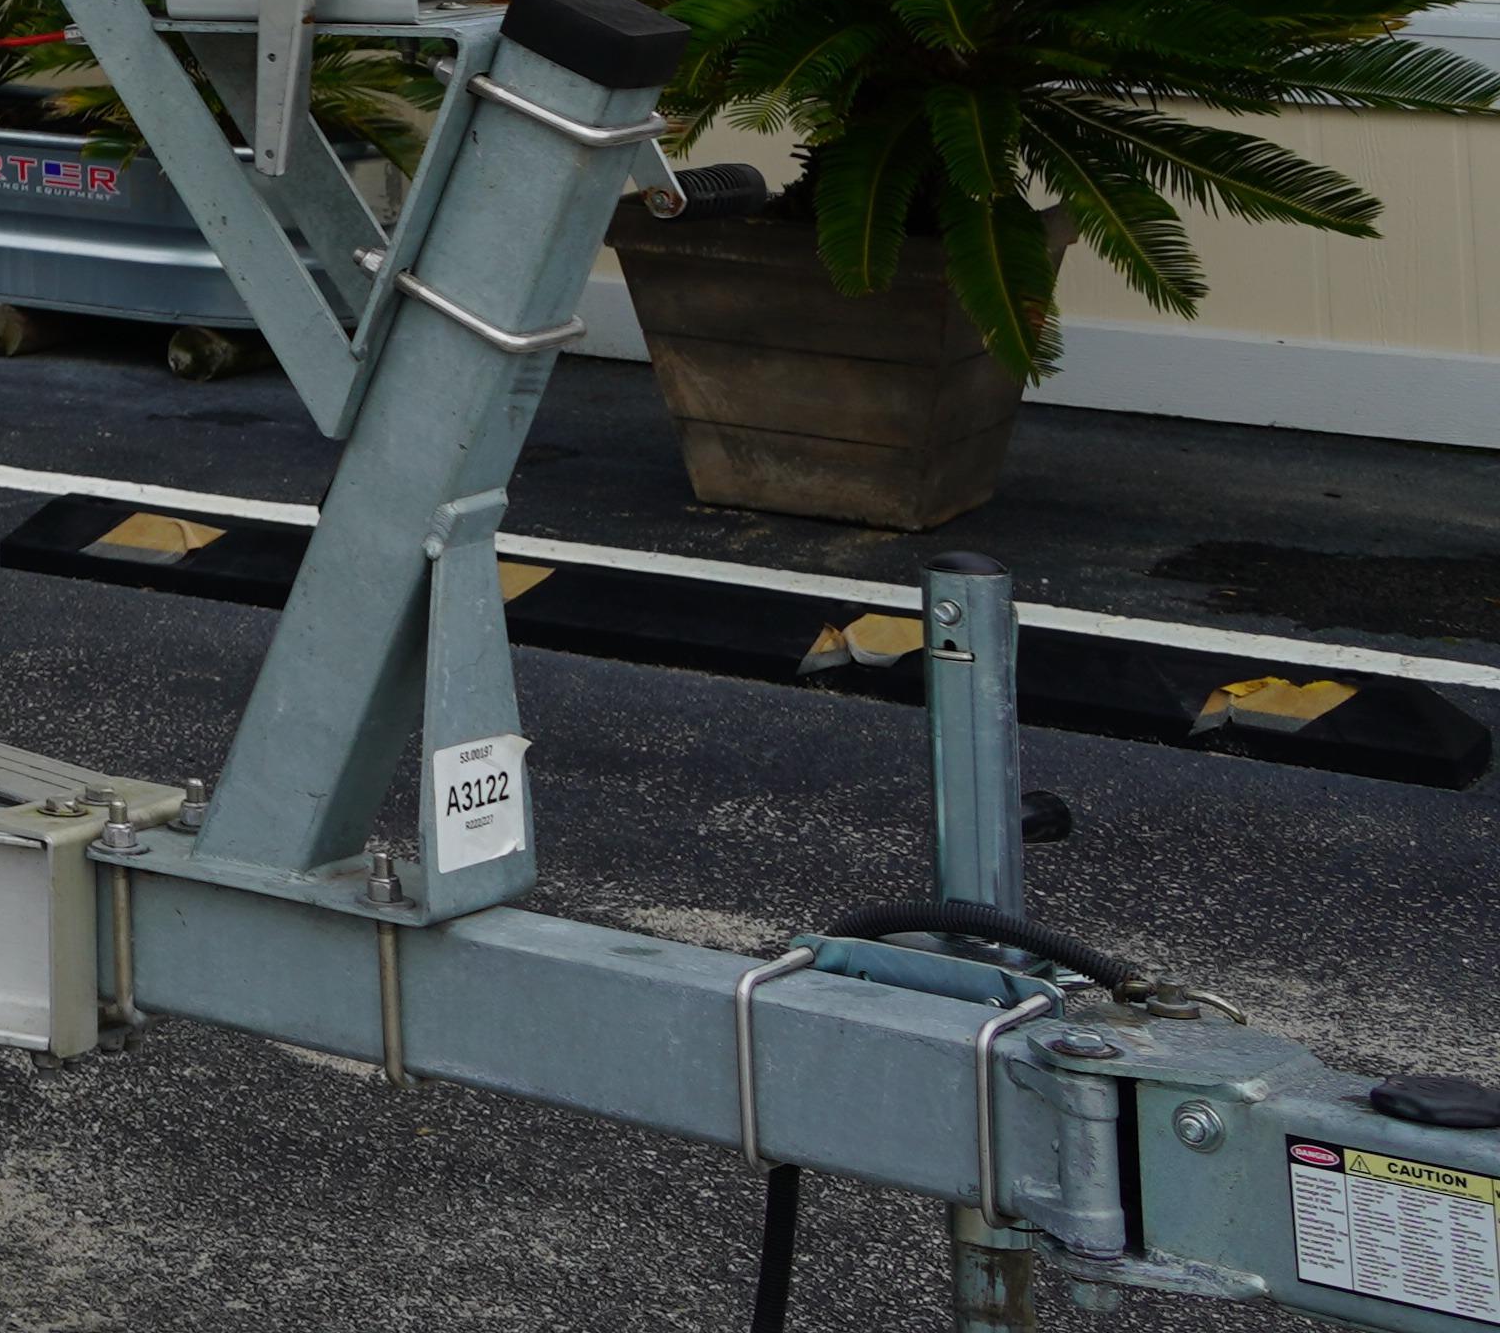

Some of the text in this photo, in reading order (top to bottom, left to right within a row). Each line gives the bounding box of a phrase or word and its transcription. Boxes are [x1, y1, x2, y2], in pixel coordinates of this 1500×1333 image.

[35, 185, 111, 202] EQUIPMENT
[446, 771, 511, 817] A3122
[1387, 1162, 1468, 1189] CAUTION
